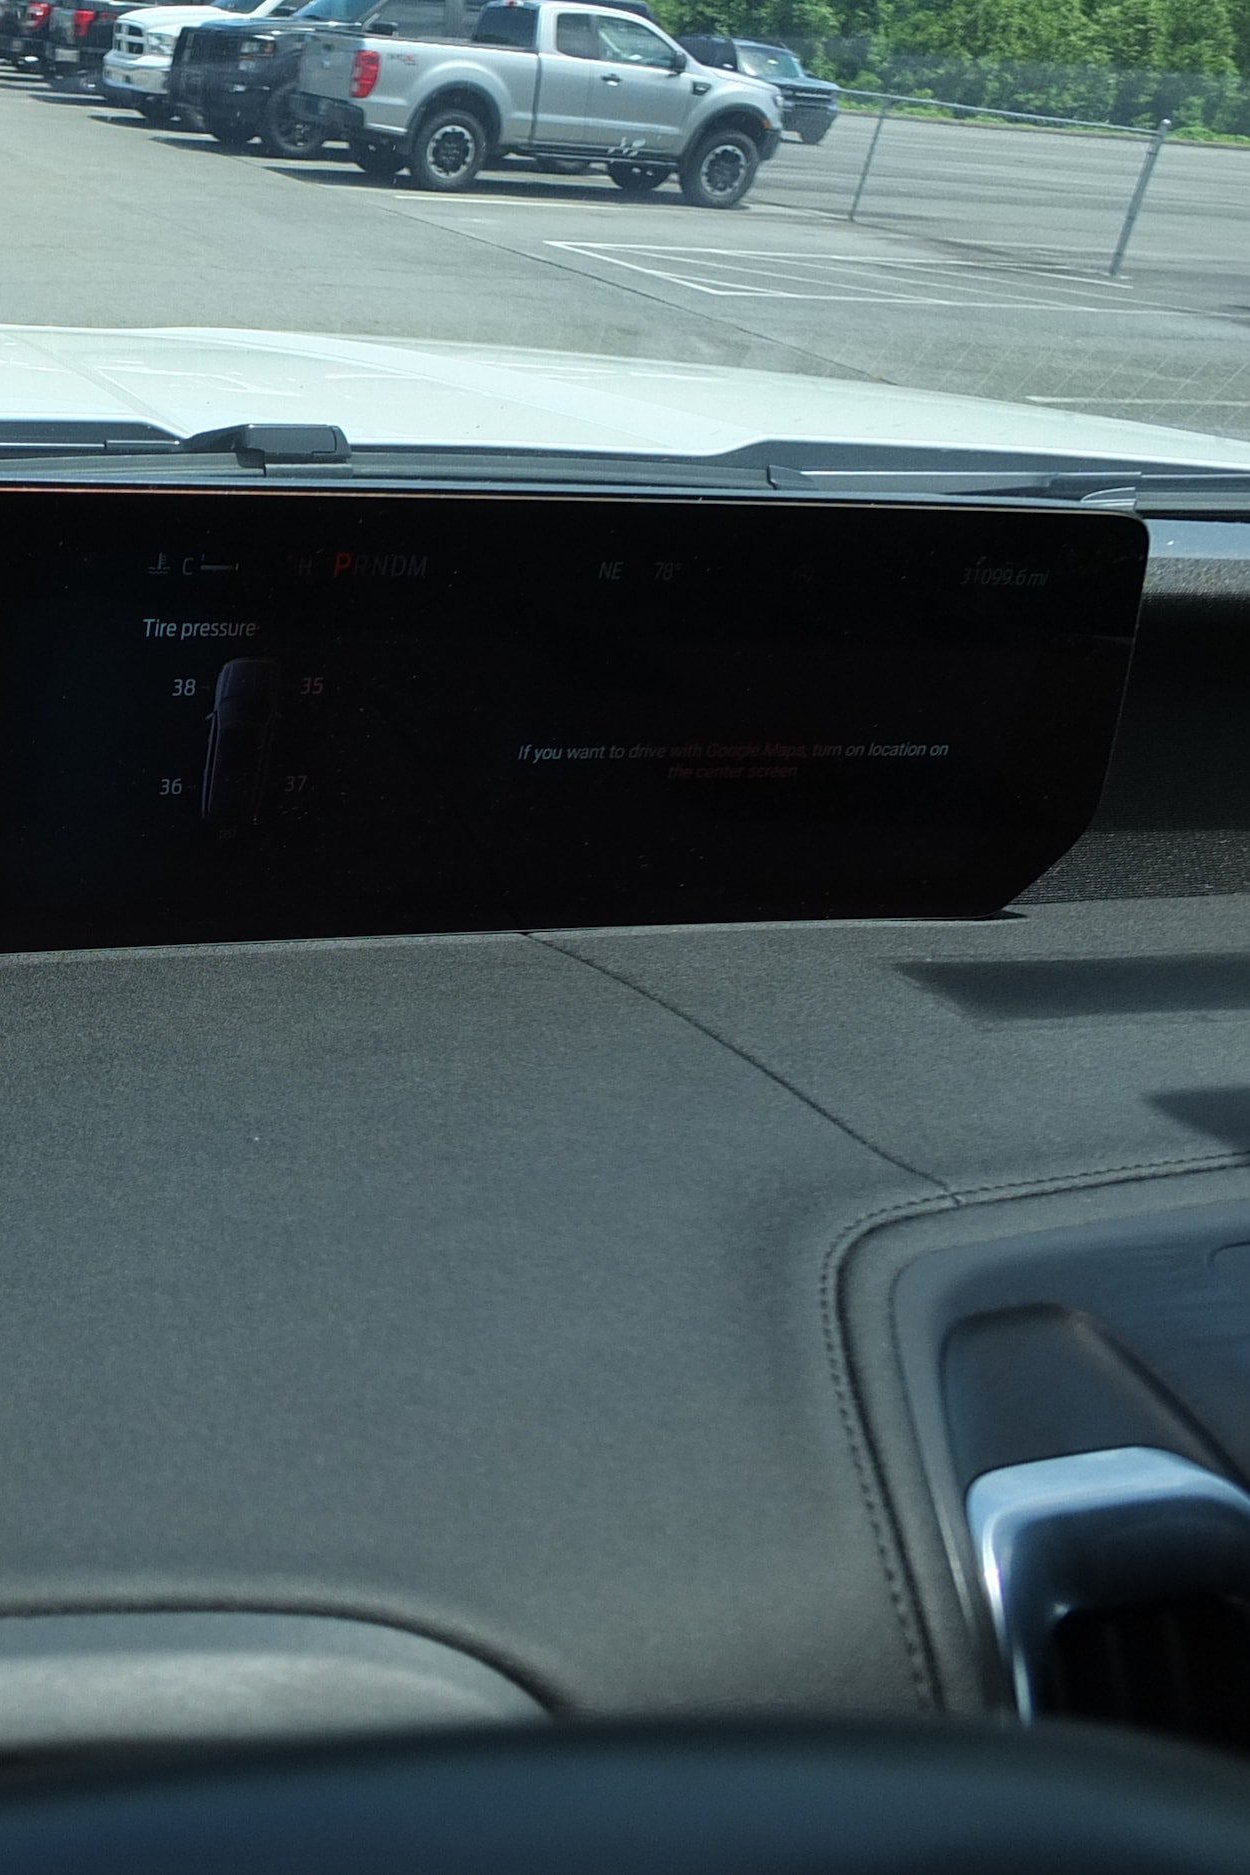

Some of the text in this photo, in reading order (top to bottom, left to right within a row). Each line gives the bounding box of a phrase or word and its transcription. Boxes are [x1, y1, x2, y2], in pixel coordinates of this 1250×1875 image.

[182, 556, 195, 576] C
[598, 560, 625, 580] NE
[142, 618, 257, 641] Tire pressure
[171, 678, 197, 697] 38
[299, 677, 325, 695] 35
[517, 744, 534, 760] If
[532, 747, 564, 764] you
[566, 746, 606, 760] want
[608, 745, 626, 760] to
[628, 743, 668, 760] drive
[670, 743, 703, 759] with
[705, 743, 761, 761] Google
[811, 743, 843, 758] turn
[844, 745, 866, 758] on
[867, 742, 928, 758] location
[929, 744, 950, 757] on
[667, 765, 799, 780] the center screen
[159, 777, 184, 796] 36
[283, 775, 309, 793] 37
